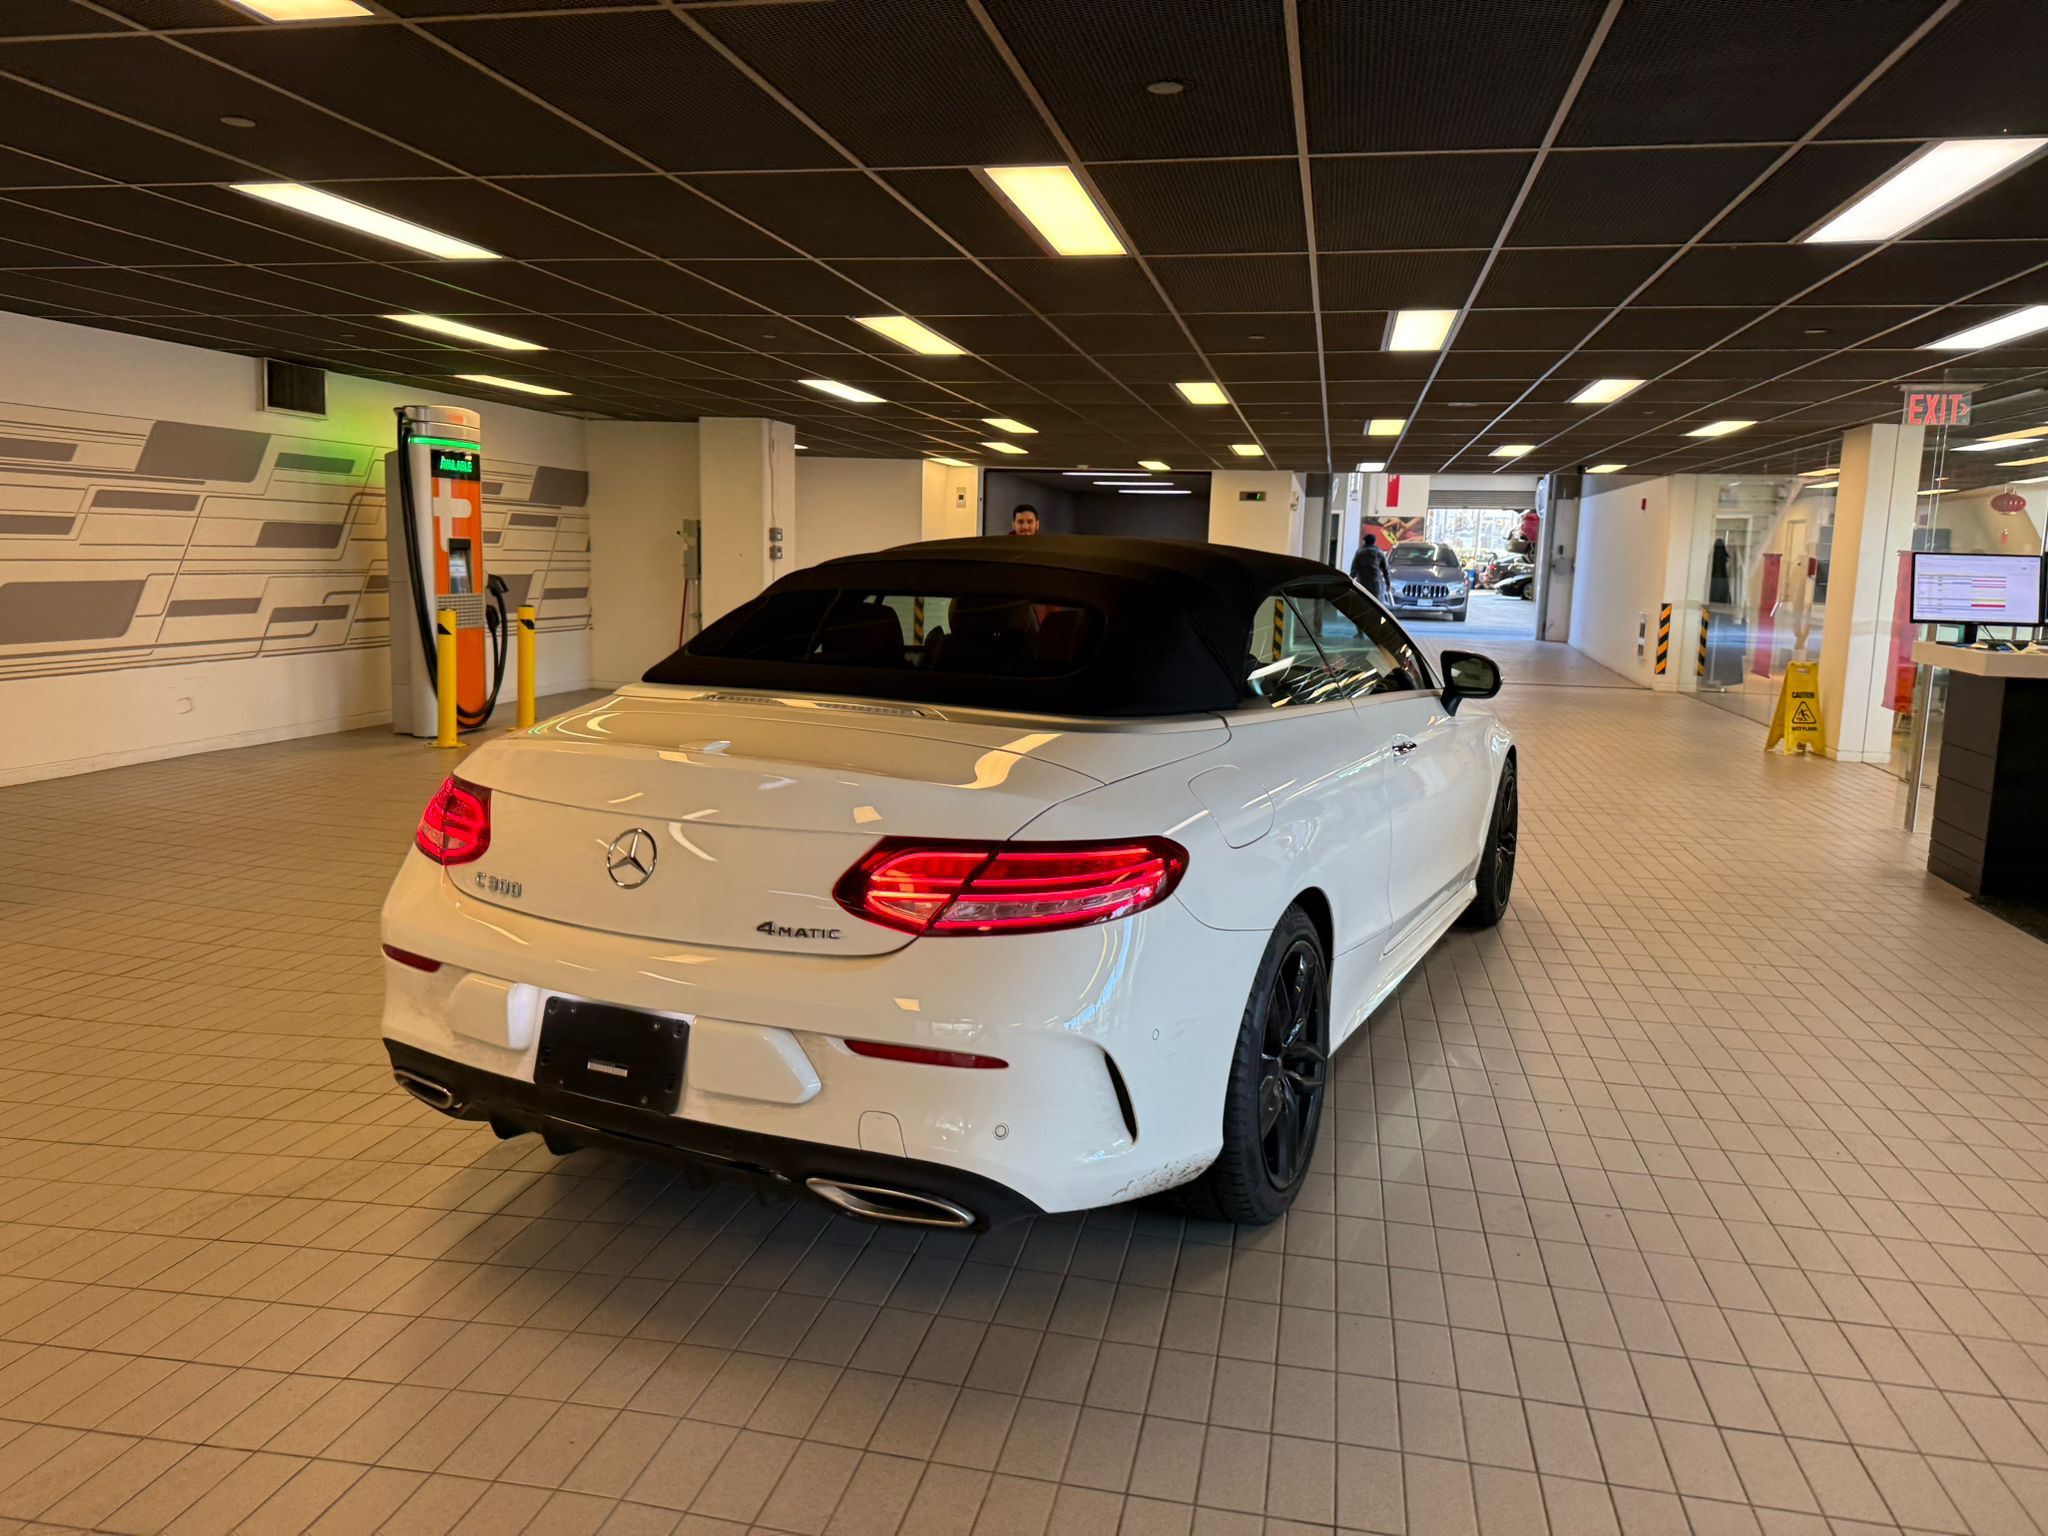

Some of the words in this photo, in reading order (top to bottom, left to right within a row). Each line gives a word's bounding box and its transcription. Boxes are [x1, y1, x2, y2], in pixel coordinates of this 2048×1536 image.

[1908, 394, 1963, 424] EXIT
[440, 456, 473, 472] AVAILABLE
[756, 921, 841, 939] 4MATIC
